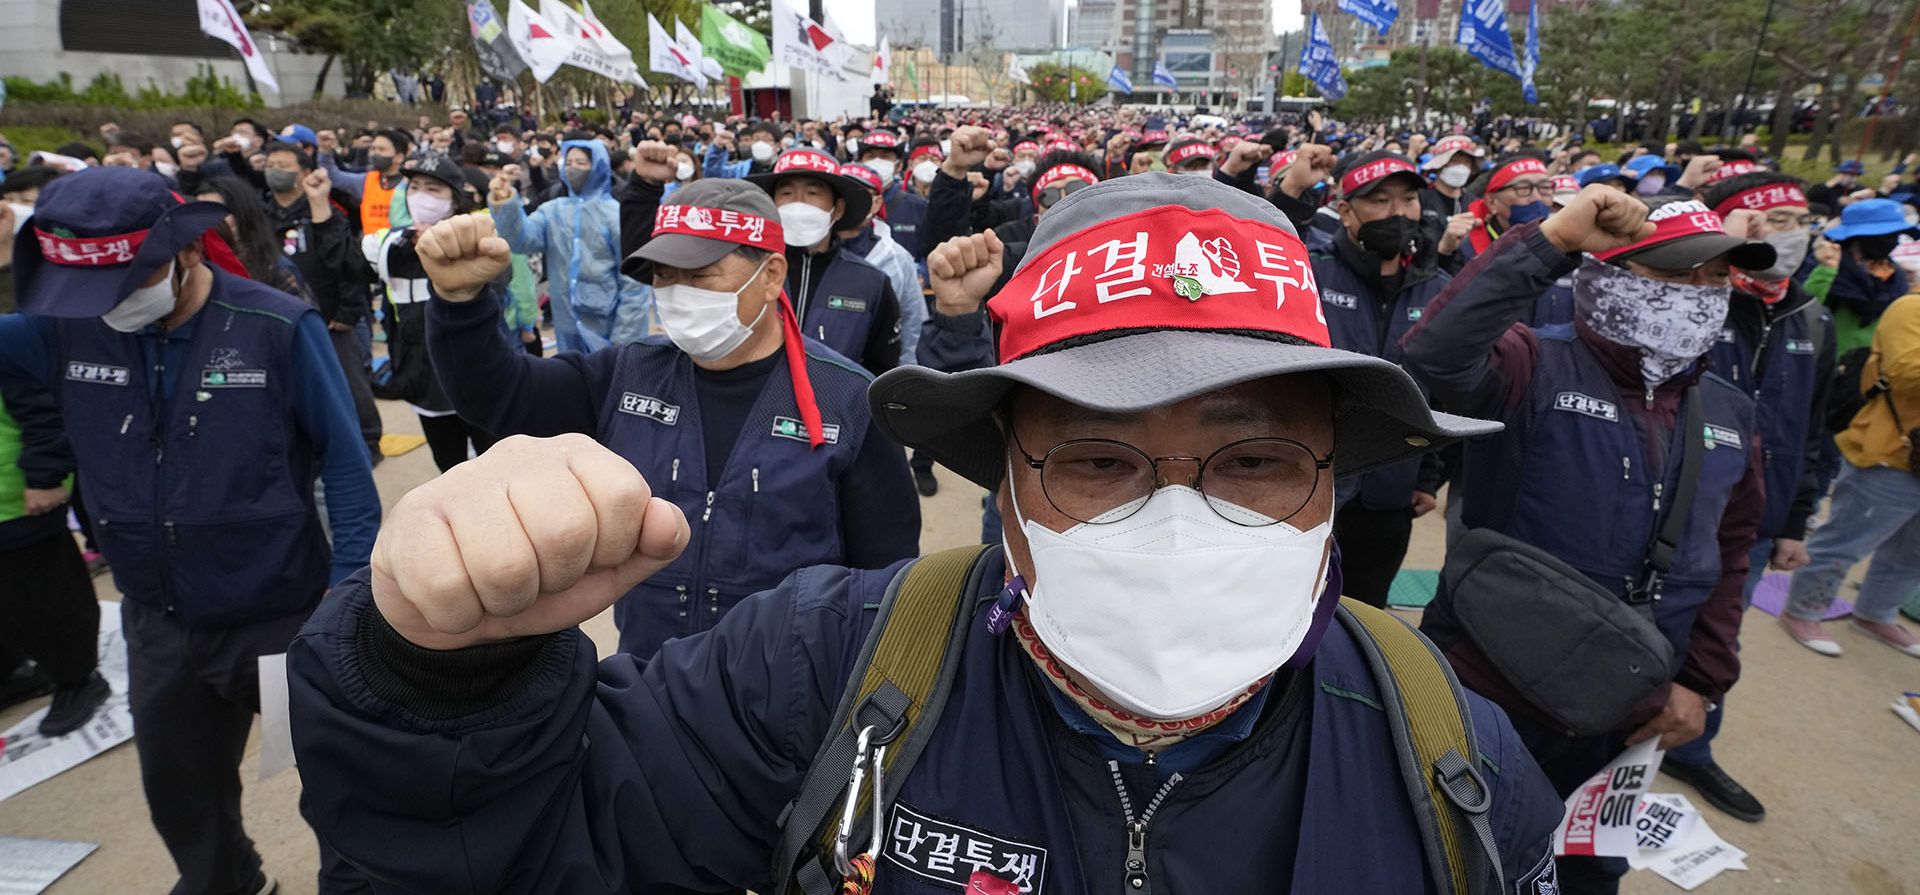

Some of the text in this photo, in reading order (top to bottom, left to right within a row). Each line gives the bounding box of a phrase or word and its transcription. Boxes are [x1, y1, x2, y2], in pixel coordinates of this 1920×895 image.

[1353, 161, 1386, 184] 단결
[1743, 187, 1787, 209] 단결
[716, 209, 765, 242] 투쟁
[80, 239, 134, 265] 투쟁
[1030, 231, 1152, 321] 단결
[1152, 262, 1199, 279] 건설노조
[623, 395, 677, 423] 단결투쟁
[1559, 395, 1617, 418] 단결투쟁
[894, 816, 1038, 893] 단결투쟁
